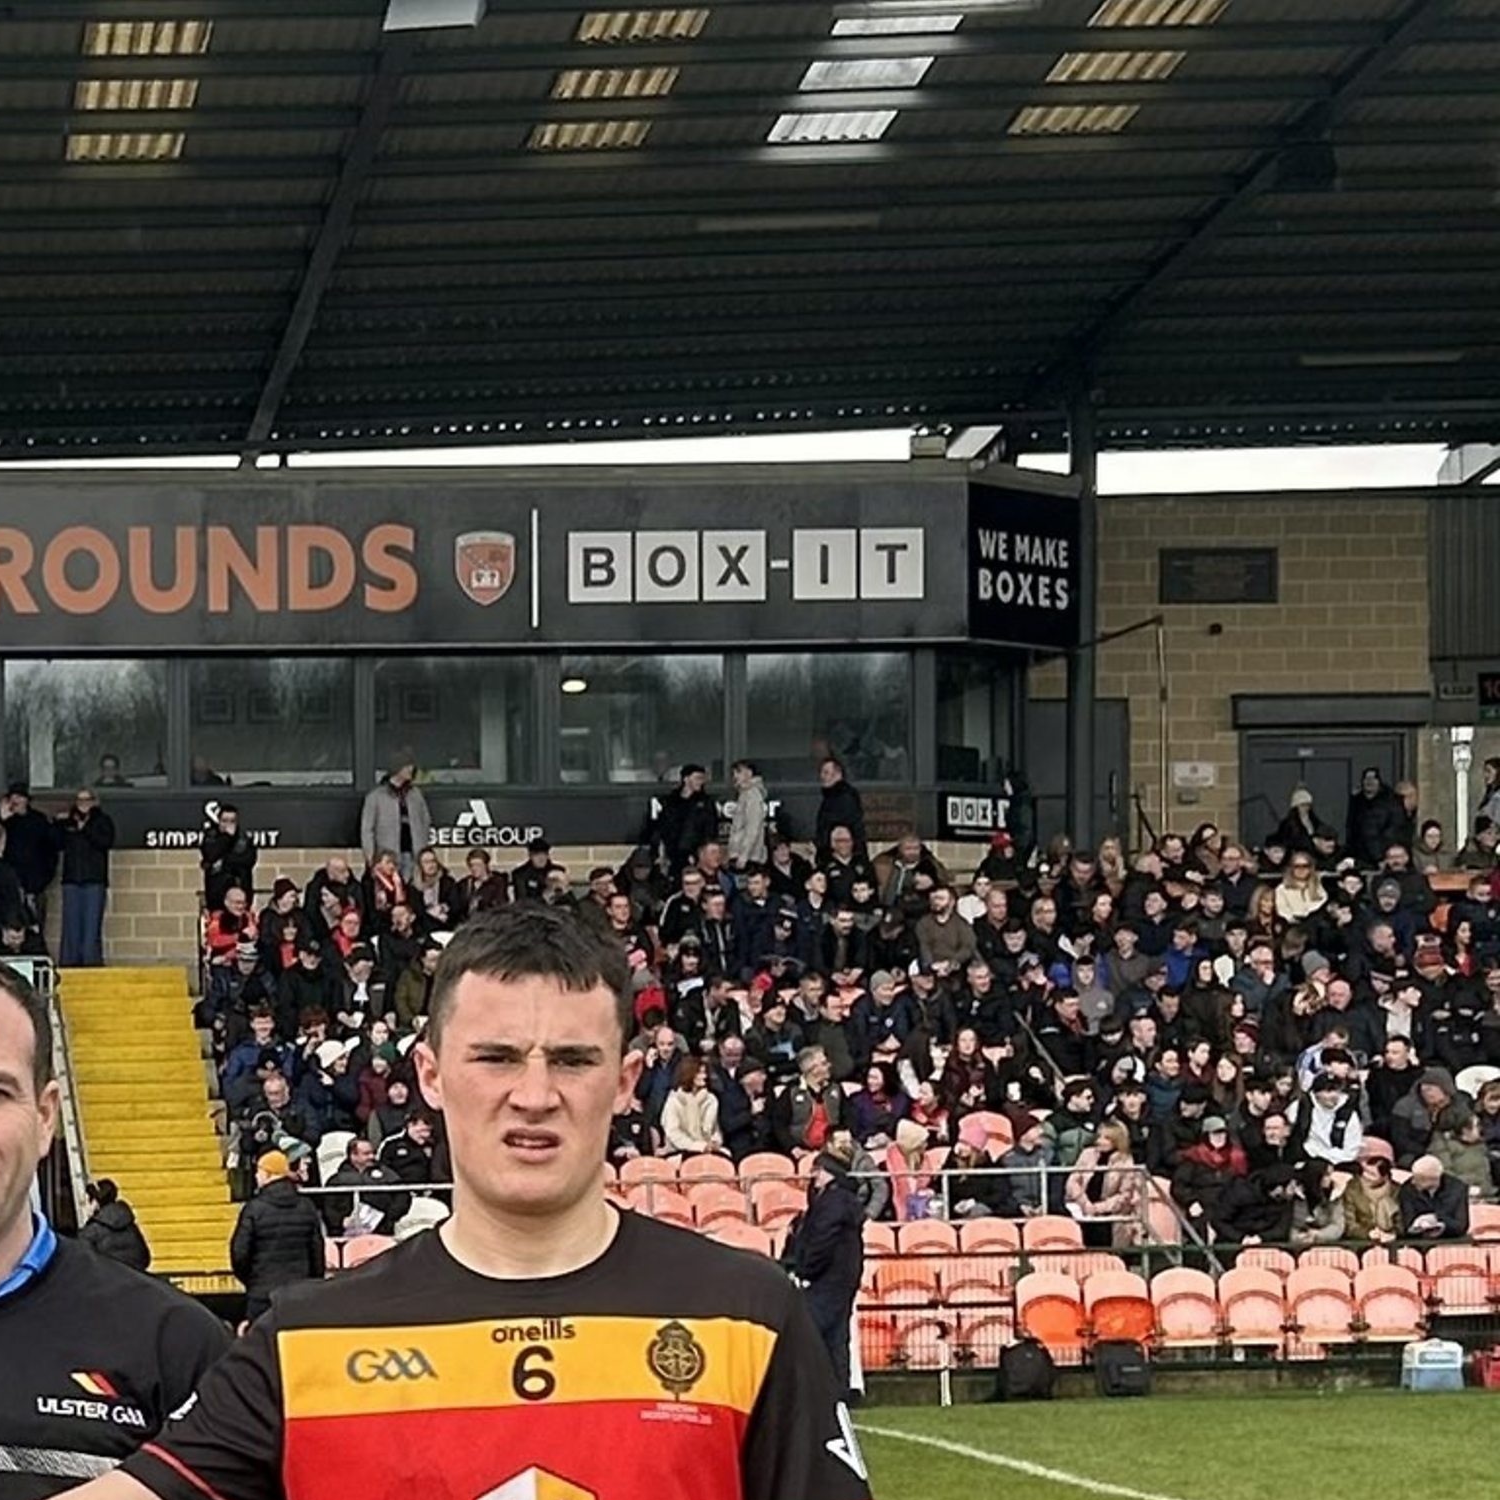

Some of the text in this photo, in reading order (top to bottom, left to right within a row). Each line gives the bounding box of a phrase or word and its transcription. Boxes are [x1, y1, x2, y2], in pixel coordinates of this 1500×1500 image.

[579, 541, 911, 590] BOX-IT
[978, 527, 1069, 569] WE MAKE
[978, 567, 1069, 611] BOXES
[345, 1347, 439, 1383] GAA
[512, 1345, 556, 1401] 6
[36, 1397, 109, 1421] ULSTER
